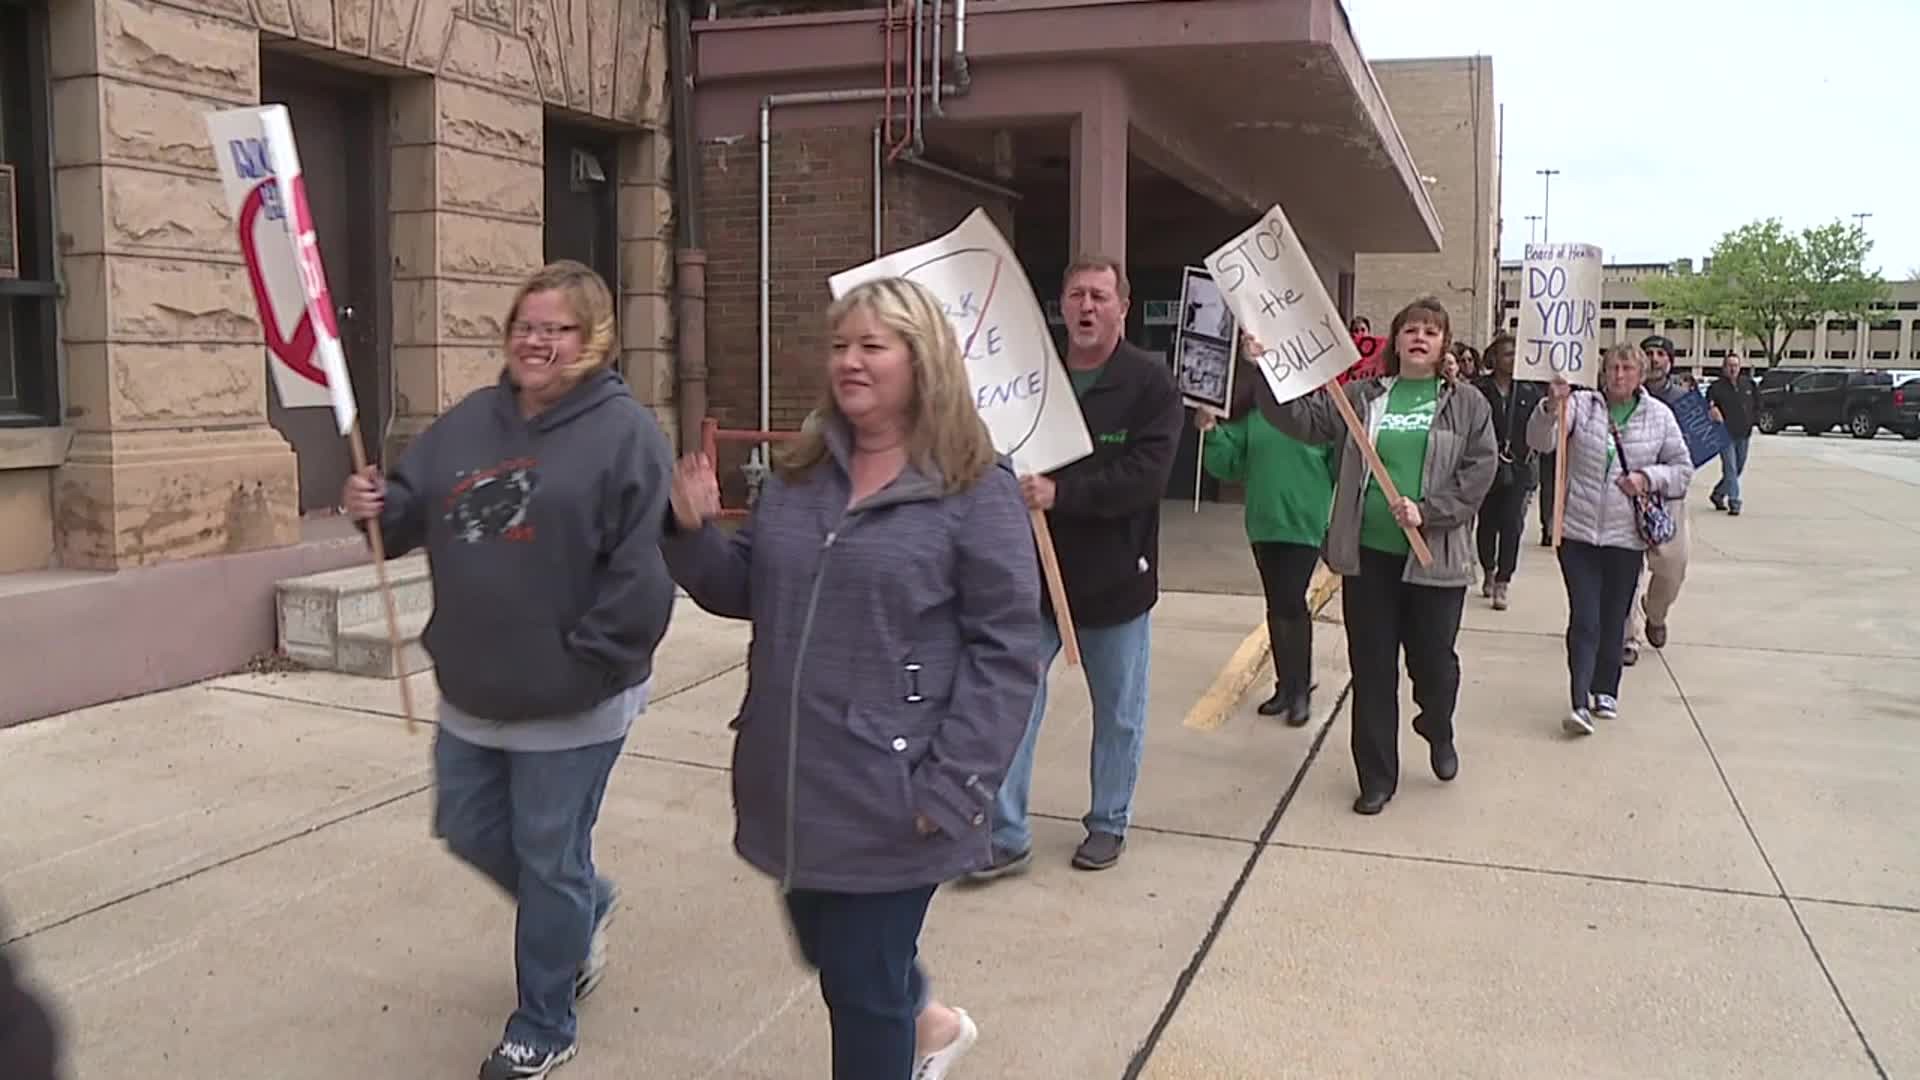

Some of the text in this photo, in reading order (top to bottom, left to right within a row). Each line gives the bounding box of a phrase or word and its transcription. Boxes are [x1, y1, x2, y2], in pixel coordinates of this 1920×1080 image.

[1215, 218, 1284, 293] STOP
[1529, 266, 1566, 299] DO
[1259, 288, 1304, 318] the
[1536, 299, 1597, 339] YOUR
[1263, 314, 1341, 383] BULLY
[1525, 339, 1583, 372] JOB
[976, 370, 1042, 409] ENCE
